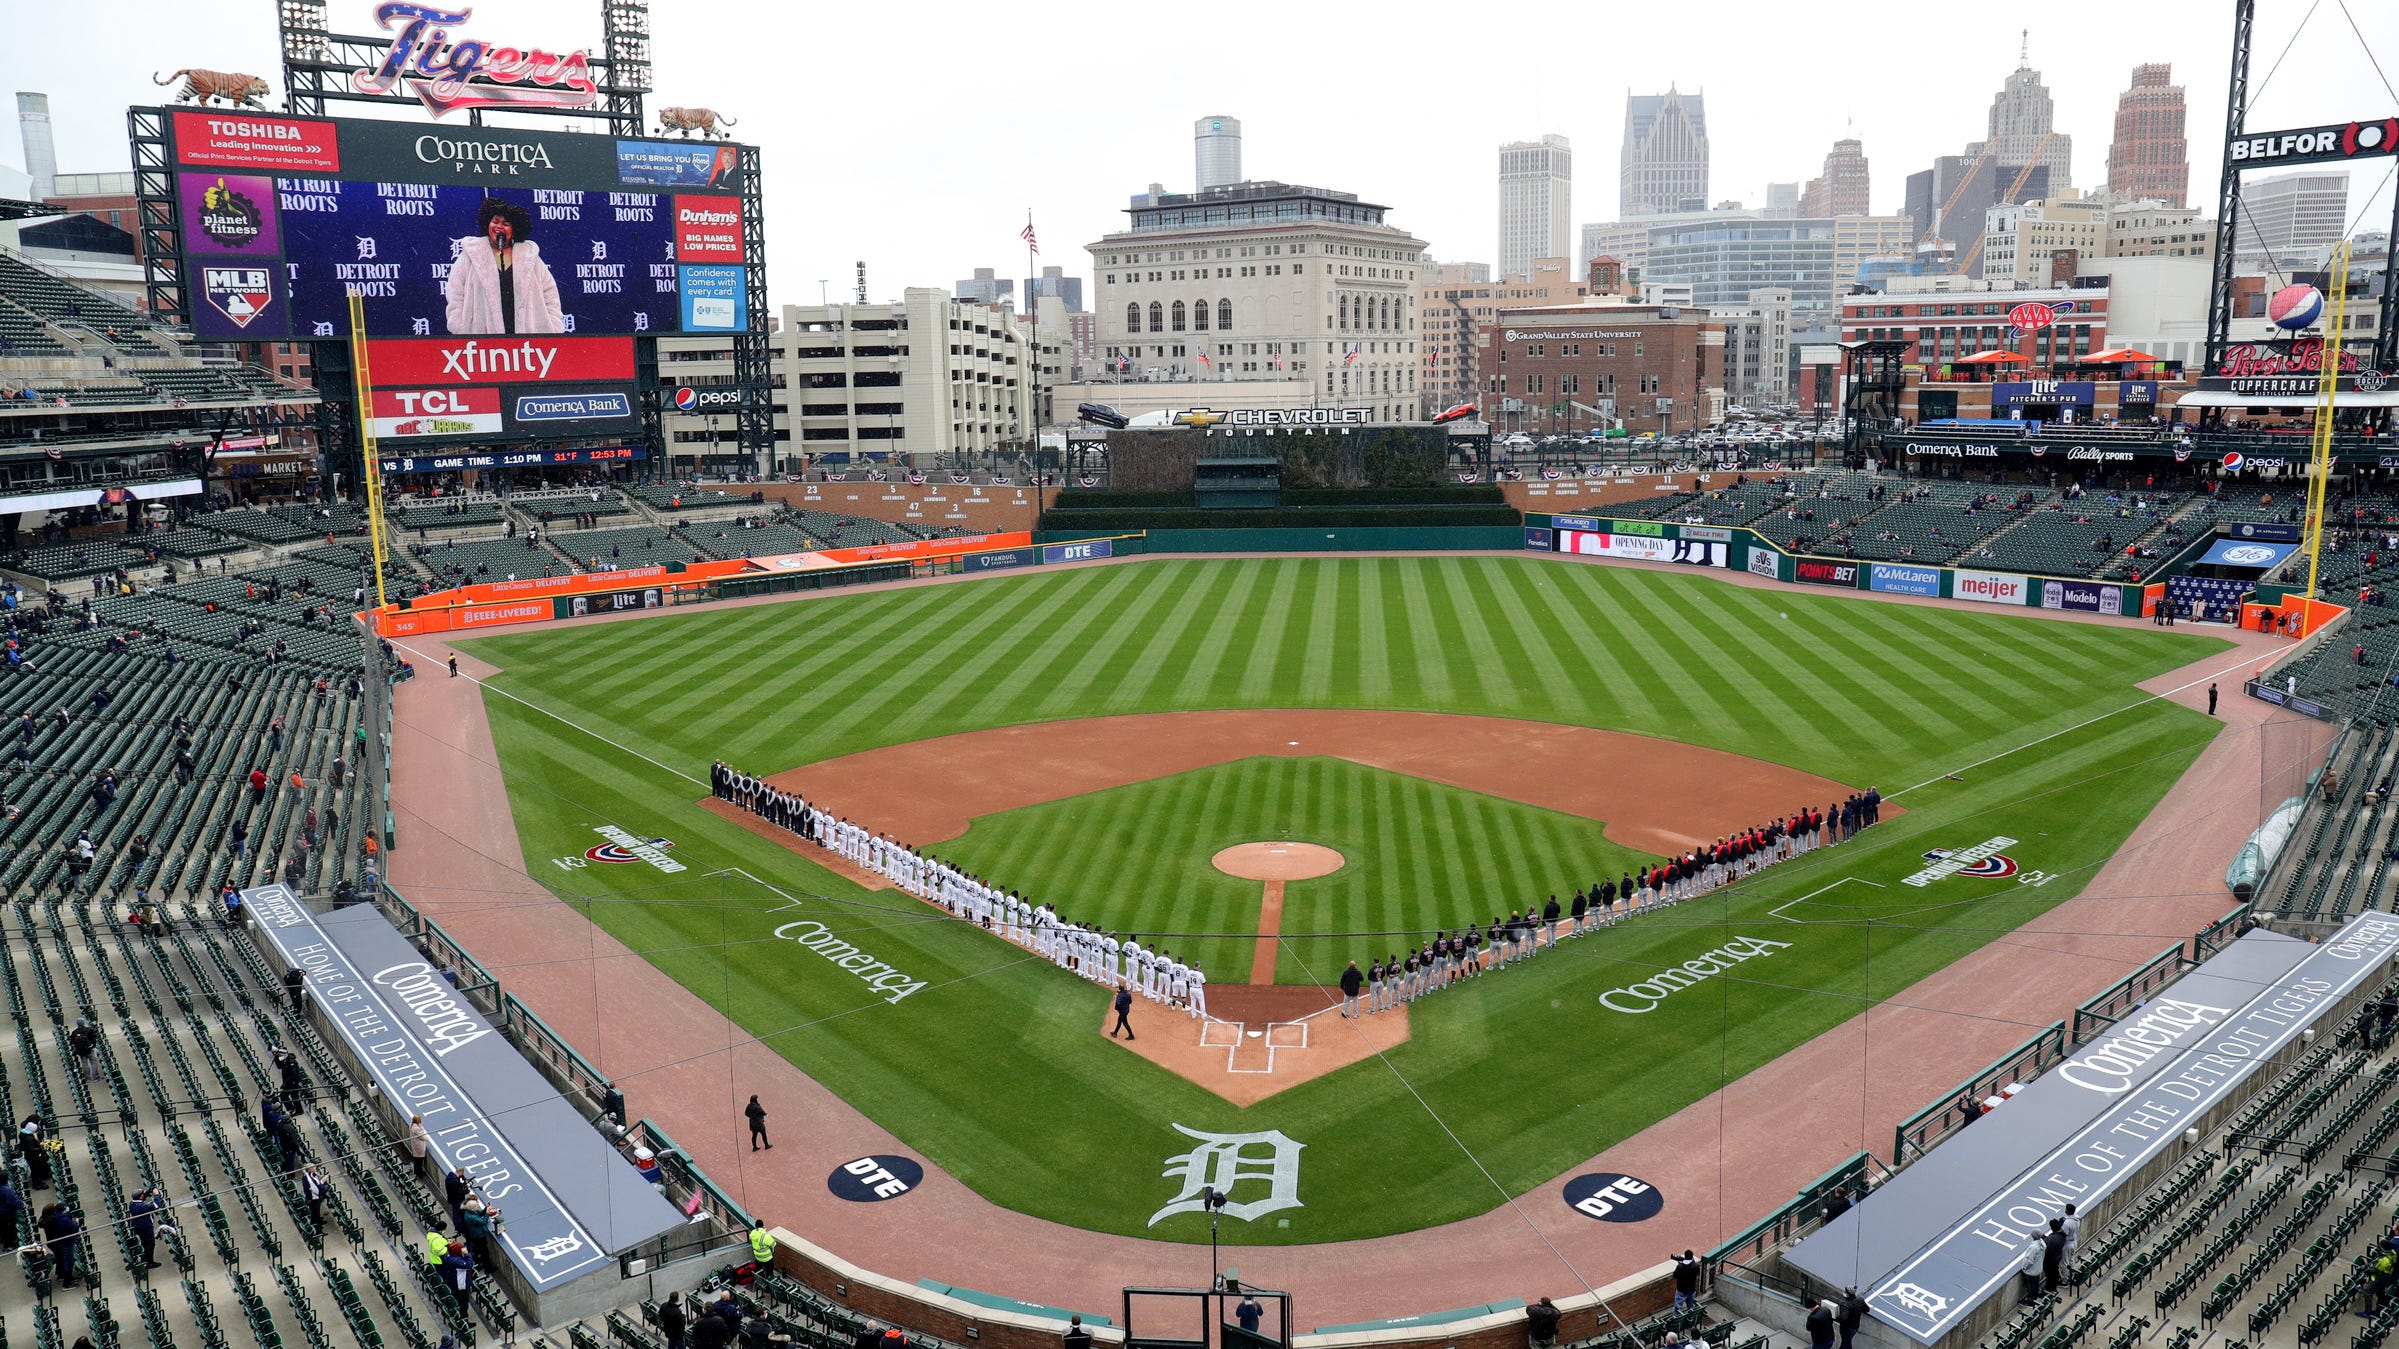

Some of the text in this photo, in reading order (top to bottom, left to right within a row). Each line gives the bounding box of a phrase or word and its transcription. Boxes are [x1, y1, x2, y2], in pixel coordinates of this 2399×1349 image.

[351, 1, 597, 108] Tigers
[208, 120, 302, 140] TOSHIBA
[210, 139, 303, 153] Leading Innovation
[2231, 132, 2337, 161] BELFOR
[187, 151, 209, 159] Official
[620, 153, 635, 161] LET
[649, 155, 673, 163] BRING
[674, 156, 691, 164] YOU
[456, 162, 519, 175] PARK
[376, 182, 439, 198] DETROIT
[280, 194, 338, 212] ROOTS
[533, 189, 585, 205] DETROIT
[609, 192, 659, 206] DETROIT
[386, 199, 434, 216] ROOTS
[540, 206, 580, 221] ROOTS
[204, 214, 248, 228] planet
[615, 208, 654, 222] ROOTS
[680, 209, 739, 224] Dunham's
[211, 223, 257, 235] fitness
[686, 234, 734, 243] BIG NAMES
[684, 242, 737, 251] LOW PRICES
[335, 263, 400, 280] DETROIT
[576, 264, 625, 278] DETROIT
[687, 268, 735, 277] Confidence
[208, 271, 267, 288] MLB
[718, 277, 736, 286] with
[345, 282, 396, 297] ROOTS
[583, 280, 621, 293] ROOTS
[688, 289, 711, 297] every
[2013, 306, 2050, 328] AAA
[441, 341, 557, 380] xfinity
[2031, 379, 2059, 396] Lite
[2131, 385, 2146, 394] Lite
[395, 390, 470, 414] TCL
[699, 390, 741, 406] pepsi
[588, 399, 621, 411] Bank
[1232, 409, 1373, 425] CHEVROLET
[1206, 428, 1350, 437] FOUNTAIN
[554, 452, 577, 461] 31°F
[590, 449, 632, 460] 12:53 PM
[1965, 445, 1998, 457] Bank
[2067, 446, 2134, 464] Bally SPORTS
[434, 456, 495, 468] GAME TIME:
[503, 453, 542, 464] 1:10 PM
[2246, 457, 2284, 468] pepsi
[263, 461, 303, 474] MARKET
[383, 462, 397, 471] VS
[1663, 475, 1671, 483] 11
[1700, 474, 1710, 483] 42
[807, 485, 818, 494] 23
[890, 485, 896, 493] 5
[931, 486, 938, 495] 2
[973, 487, 981, 496] 16
[1016, 489, 1023, 498] 6
[909, 503, 919, 511] 47
[952, 504, 959, 512] 3
[962, 535, 987, 544] DELIVERY
[1528, 539, 1548, 547] Fanatics
[1615, 537, 1664, 550] OPENING DAY
[890, 543, 917, 552] DELIVERY
[1065, 545, 1091, 557] DTE
[629, 569, 661, 578] DELIVERY
[1750, 562, 1776, 577] VISION
[1891, 568, 1936, 583] McLaren
[536, 578, 571, 587] DELIVERY
[1962, 577, 2018, 599] meijer
[613, 594, 636, 609] Lite
[2065, 590, 2097, 604] Modelo
[293, 943, 523, 1201] HOME OF THE DETROIT TIGERS
[1972, 976, 2332, 1251] HOME OF THE DETROIT TIGERS
[843, 1157, 909, 1198] DTE
[1574, 1176, 1650, 1217] DTE
